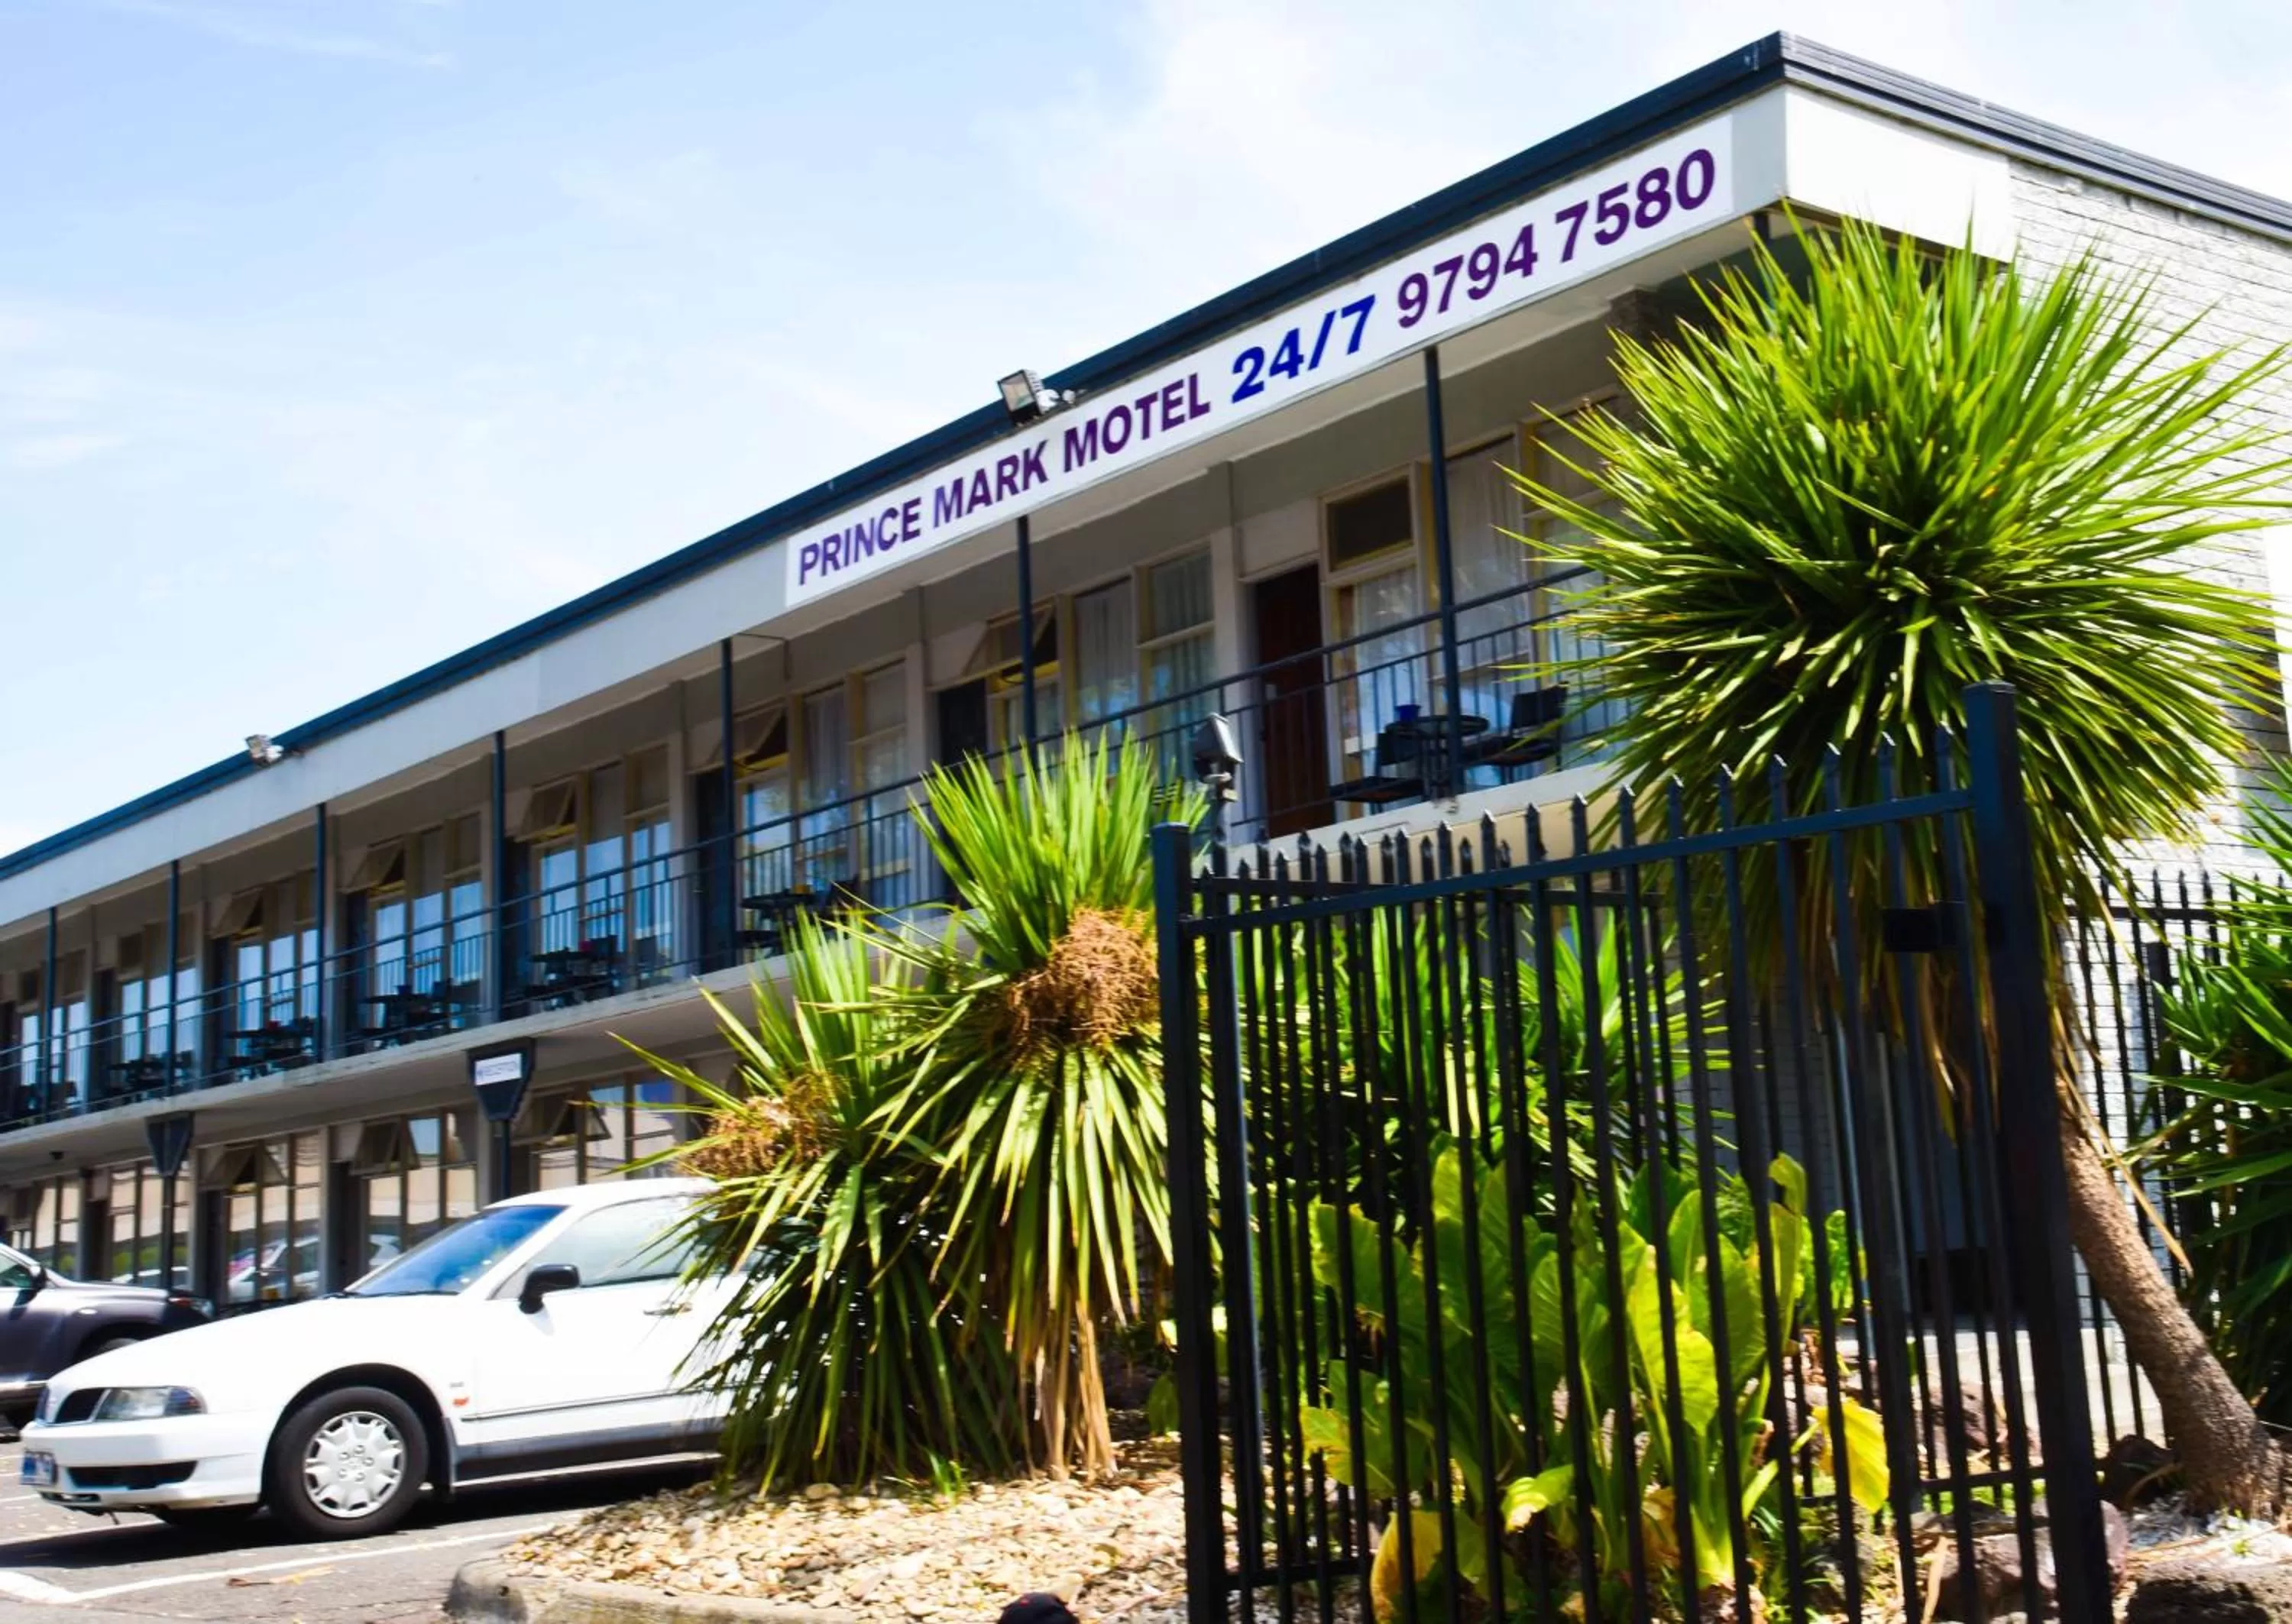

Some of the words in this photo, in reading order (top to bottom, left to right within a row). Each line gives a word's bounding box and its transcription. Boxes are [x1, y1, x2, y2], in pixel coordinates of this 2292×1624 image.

[799, 497, 921, 586] PRINCE
[933, 439, 1049, 529] MARK
[1063, 373, 1211, 474] MOTEL
[1231, 294, 1375, 403] 24/7
[1397, 223, 1539, 328] 9794
[1555, 148, 1716, 263] 7580
